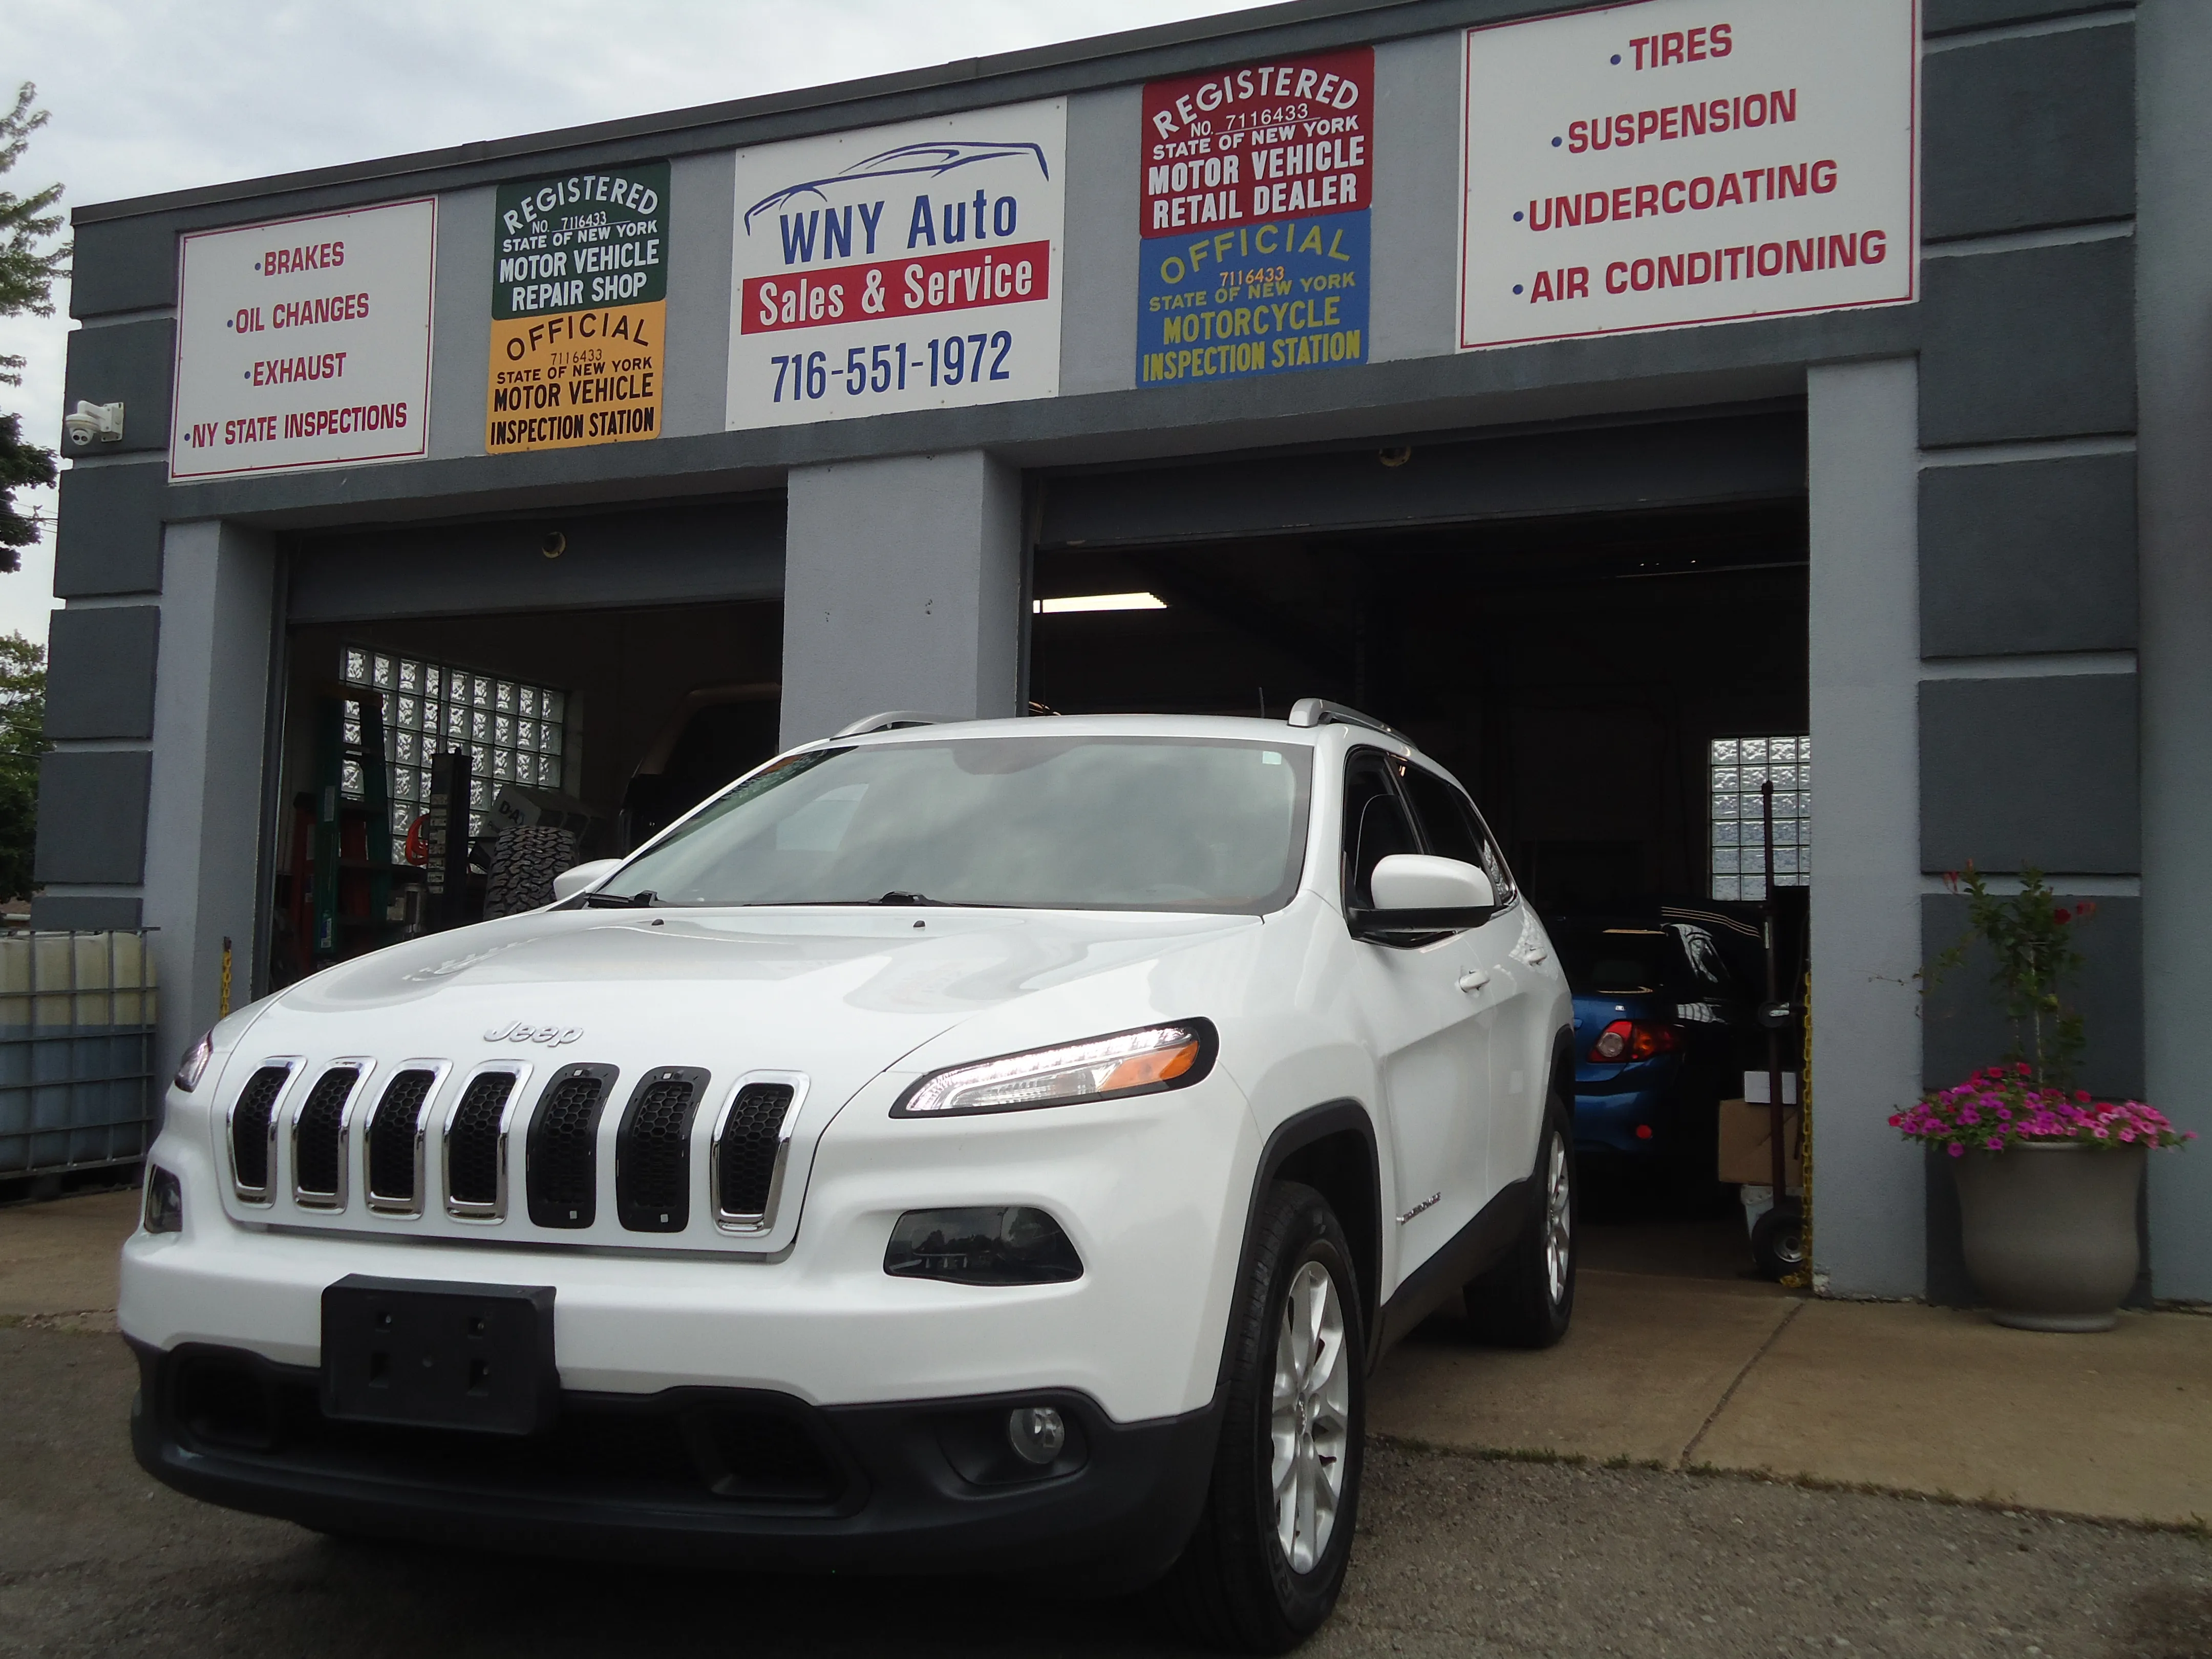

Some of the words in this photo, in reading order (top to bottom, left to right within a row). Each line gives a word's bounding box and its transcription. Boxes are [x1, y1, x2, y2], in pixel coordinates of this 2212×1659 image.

[1629, 23, 1733, 71] TIRES
[1153, 67, 1359, 139] REGISTERED
[1190, 120, 1214, 137] NO.
[1225, 103, 1309, 130] 7116433
[1568, 89, 1797, 154] SUSPENSION
[1153, 138, 1211, 160] STATE
[1219, 133, 1245, 151] OF
[1251, 126, 1294, 145] NEW
[1305, 115, 1359, 137] YORK
[1148, 156, 1240, 196] MOTOR
[1252, 135, 1365, 180] VEHICLE
[503, 176, 658, 235] REGISTERED
[1153, 190, 1242, 229] RETAIL
[1254, 173, 1357, 216] DEALER
[1528, 159, 1838, 232] UNDERCOATING
[503, 236, 547, 252] STATE
[552, 232, 571, 246] OF
[578, 228, 609, 243] NEW
[616, 220, 657, 238] YORK
[532, 221, 549, 233] NO.
[561, 211, 607, 228] 7116433
[779, 200, 885, 265] WNY
[907, 189, 1016, 249] Auto
[264, 241, 345, 276] BRAKES
[499, 252, 566, 283] MOTOR
[573, 239, 659, 271] VEHICLE
[1160, 223, 1351, 284] OFFICIAL
[1220, 266, 1285, 287] 7116433
[1530, 266, 1589, 304] AIR
[1605, 230, 1887, 296] CONDITIONING
[236, 308, 265, 334] OIL
[273, 293, 369, 329] CHANGES
[512, 279, 584, 311] REPAIR
[592, 272, 647, 302] SHOP
[759, 279, 844, 326] Sales
[862, 269, 885, 314] &
[904, 256, 1032, 309] Service
[1150, 291, 1206, 312] STATE
[1215, 287, 1239, 303] OF
[1248, 280, 1292, 299] NEW
[1300, 271, 1355, 292] YORK
[506, 313, 650, 360] OFFICIAL
[1163, 296, 1341, 345] MOTORCYCLE
[253, 352, 347, 387] EXHAUST
[497, 369, 541, 385] STATE
[547, 365, 566, 379] OF
[572, 361, 605, 376] NEW
[612, 356, 653, 373] YORK
[551, 349, 602, 366] 7116433
[771, 330, 1012, 402] 716-551-1972
[1143, 341, 1265, 382] INSPECTION
[1272, 330, 1360, 368] STATION
[494, 384, 561, 412] MOTOR
[569, 373, 654, 405] VEHICLE
[192, 422, 218, 449] NY
[225, 416, 277, 445] STATE
[284, 402, 408, 439] INSPECTIONS
[491, 414, 584, 445] INSPECTION
[589, 407, 654, 437] STATION
[484, 1020, 584, 1047] Jeep
